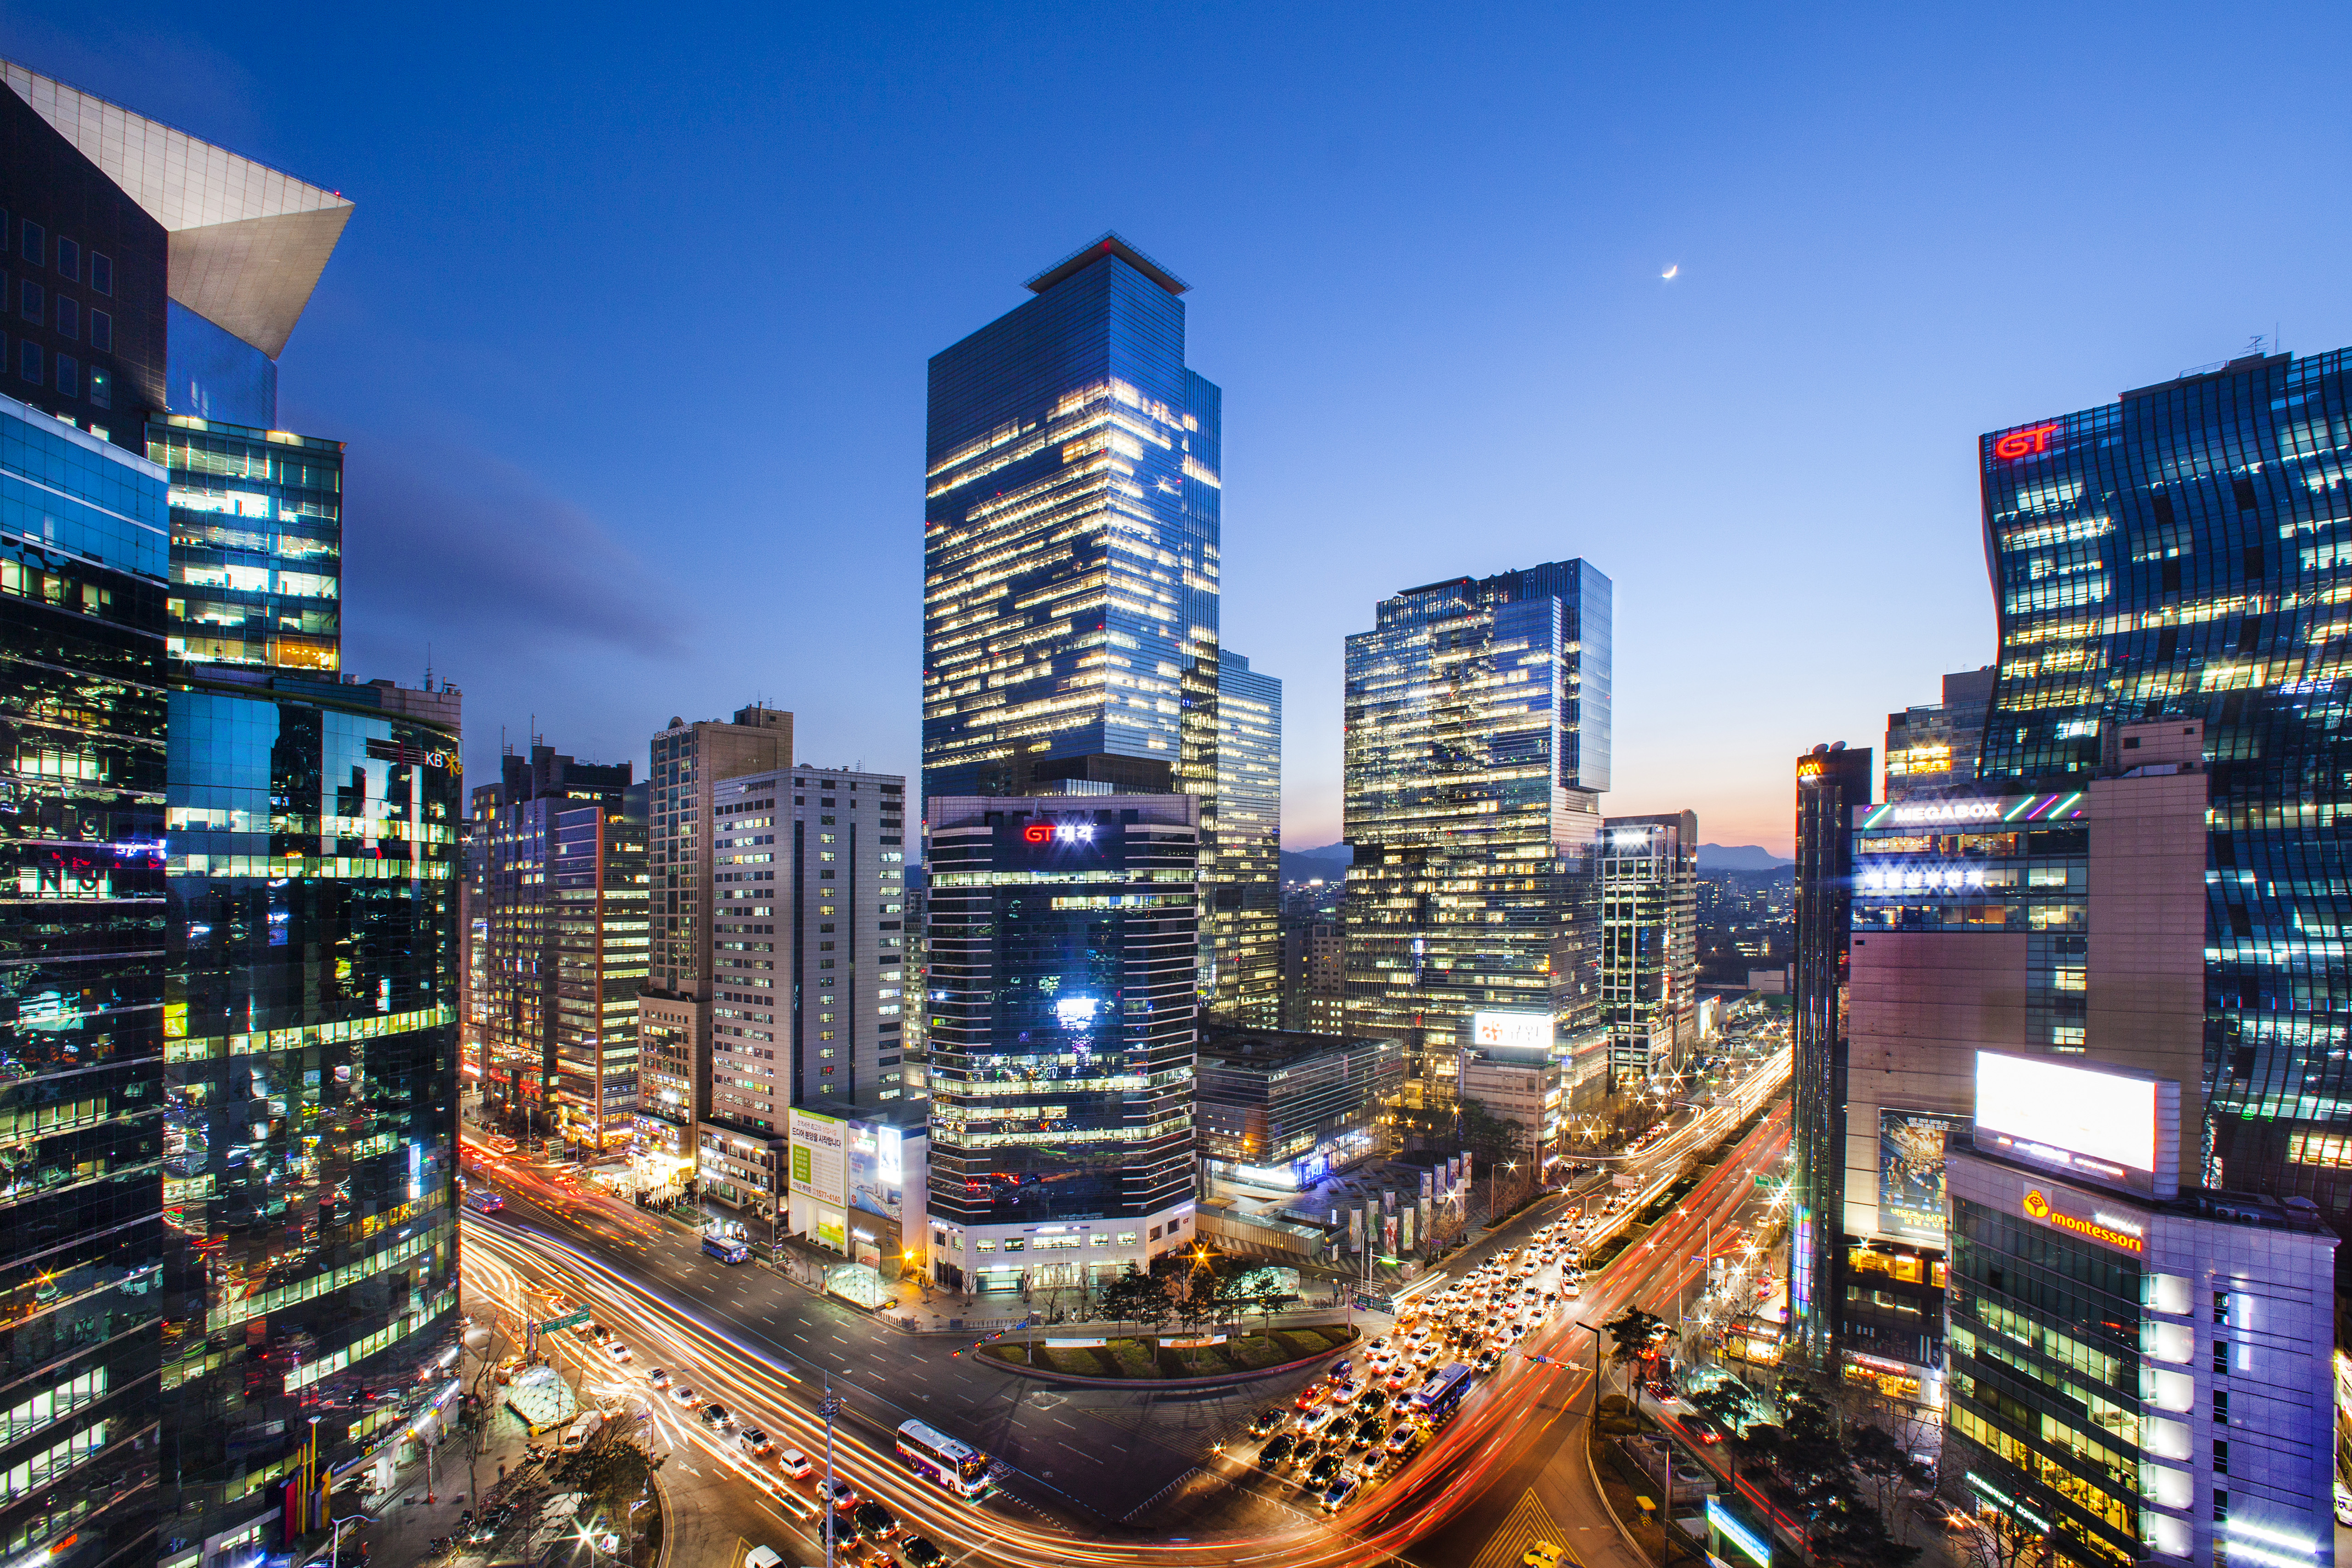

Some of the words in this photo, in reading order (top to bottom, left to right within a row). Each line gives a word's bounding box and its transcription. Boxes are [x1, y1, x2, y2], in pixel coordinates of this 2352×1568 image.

[1996, 425, 2058, 459] GT
[425, 751, 443, 768] KB
[1894, 803, 2000, 821] MEGABOX
[792, 1127, 804, 1138] 드디어
[805, 1131, 818, 1142] 분양을
[819, 1134, 841, 1149] 시작합니다
[816, 1189, 841, 1204] 1577-4140
[2052, 1213, 2143, 1252] montessori
